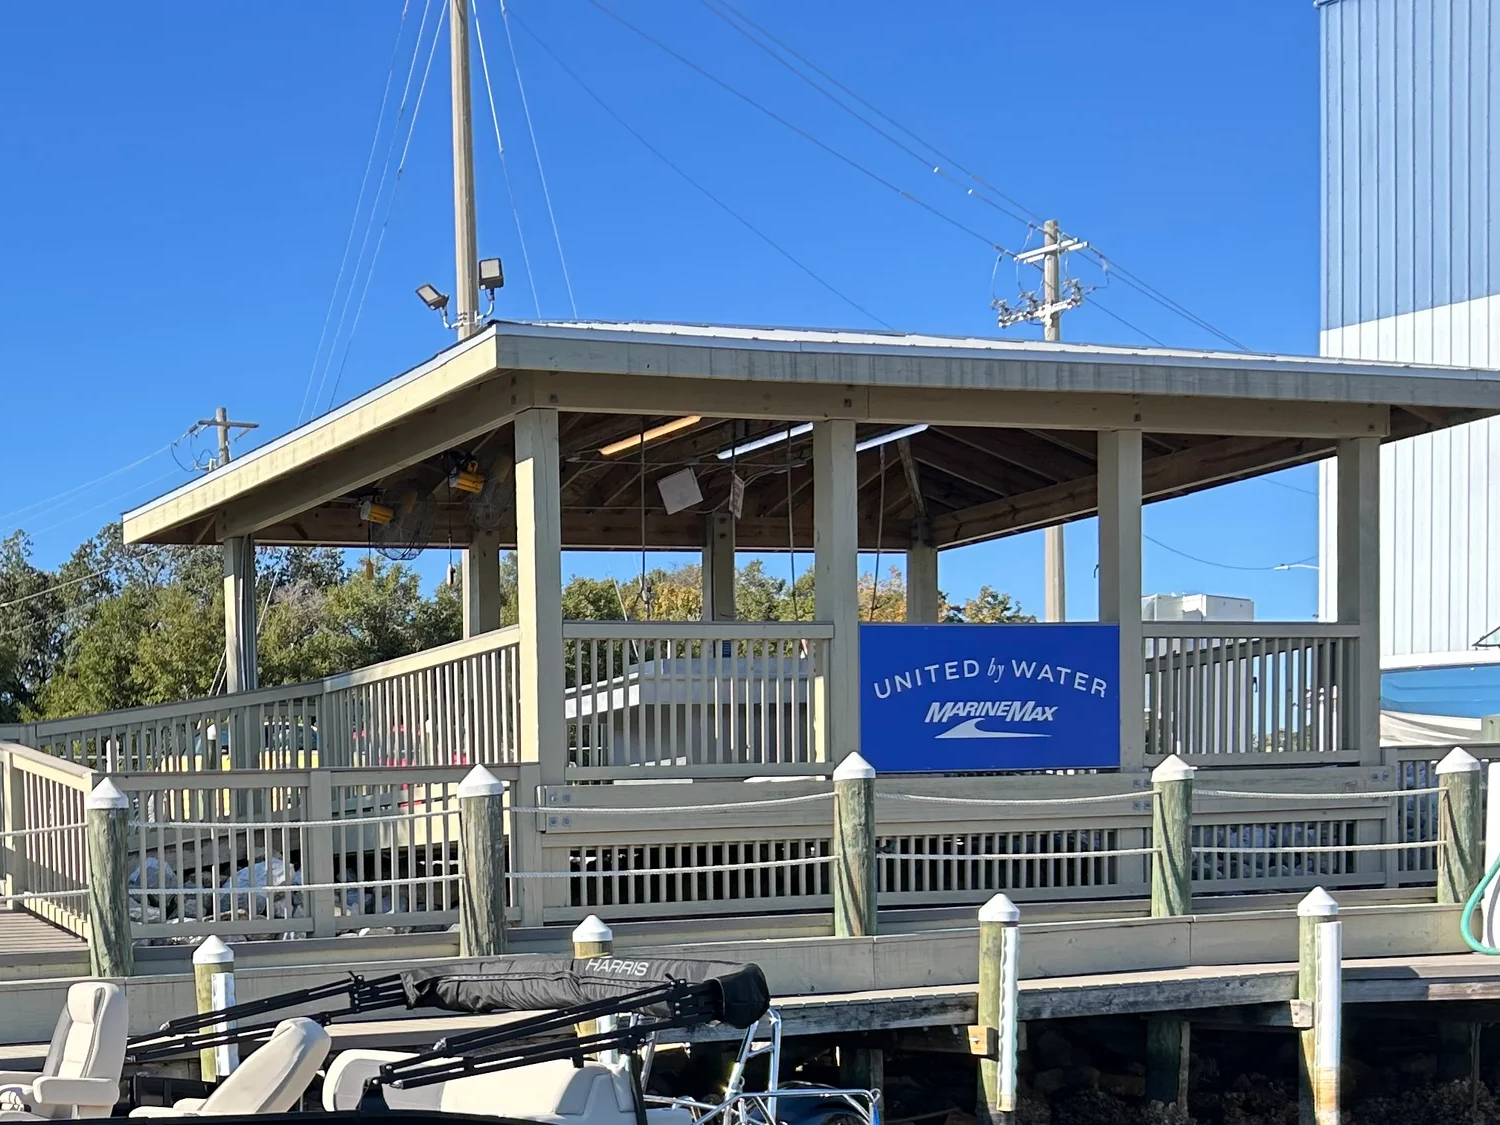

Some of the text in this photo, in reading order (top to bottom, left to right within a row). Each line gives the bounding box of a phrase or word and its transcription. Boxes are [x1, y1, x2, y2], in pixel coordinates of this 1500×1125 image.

[873, 657, 1108, 700] UNITED by WATER
[585, 958, 649, 976] HARRIS
